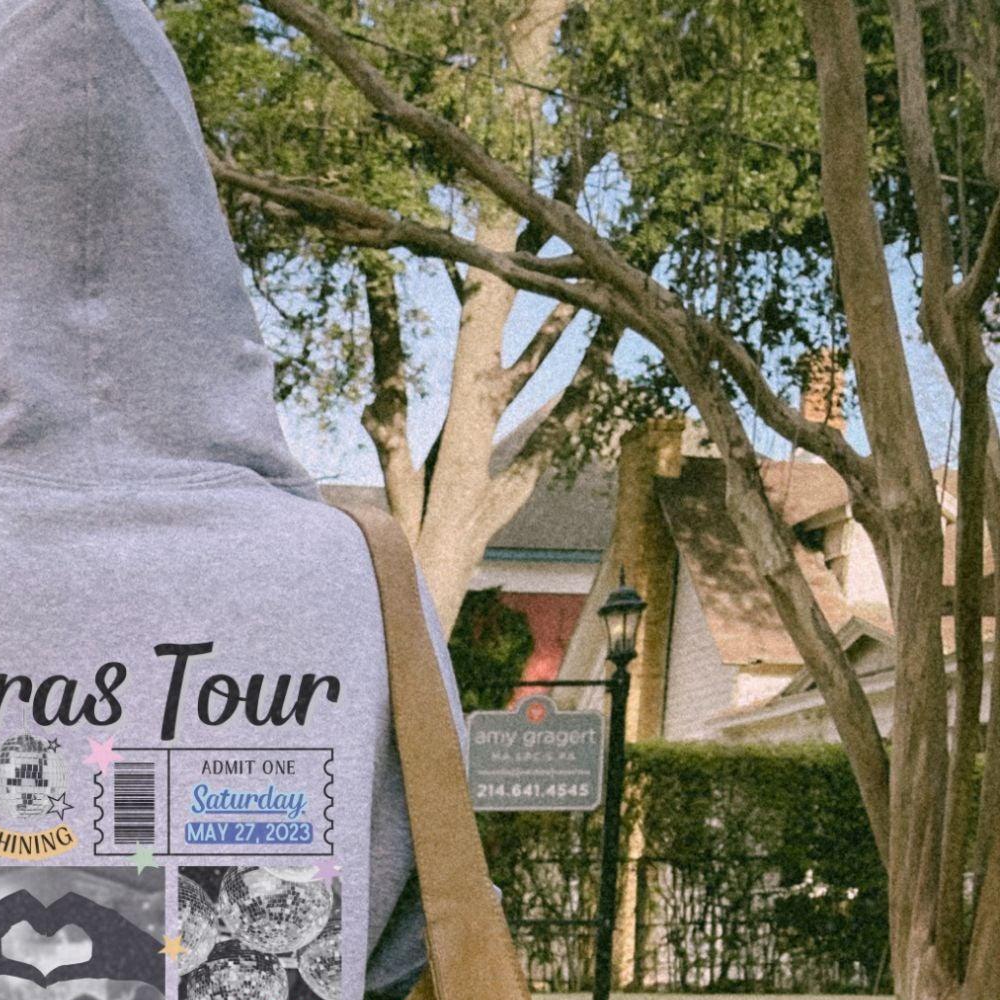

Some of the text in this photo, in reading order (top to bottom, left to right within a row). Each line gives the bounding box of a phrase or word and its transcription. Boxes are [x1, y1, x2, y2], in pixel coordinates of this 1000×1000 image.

[153, 641, 341, 741] Tour
[474, 728, 597, 747] amy gragert
[201, 760, 295, 775] ADMIT ONE
[477, 783, 590, 798] 214.641.4545
[191, 784, 307, 819] Saturday
[187, 823, 311, 844] MAY 27, 2023
